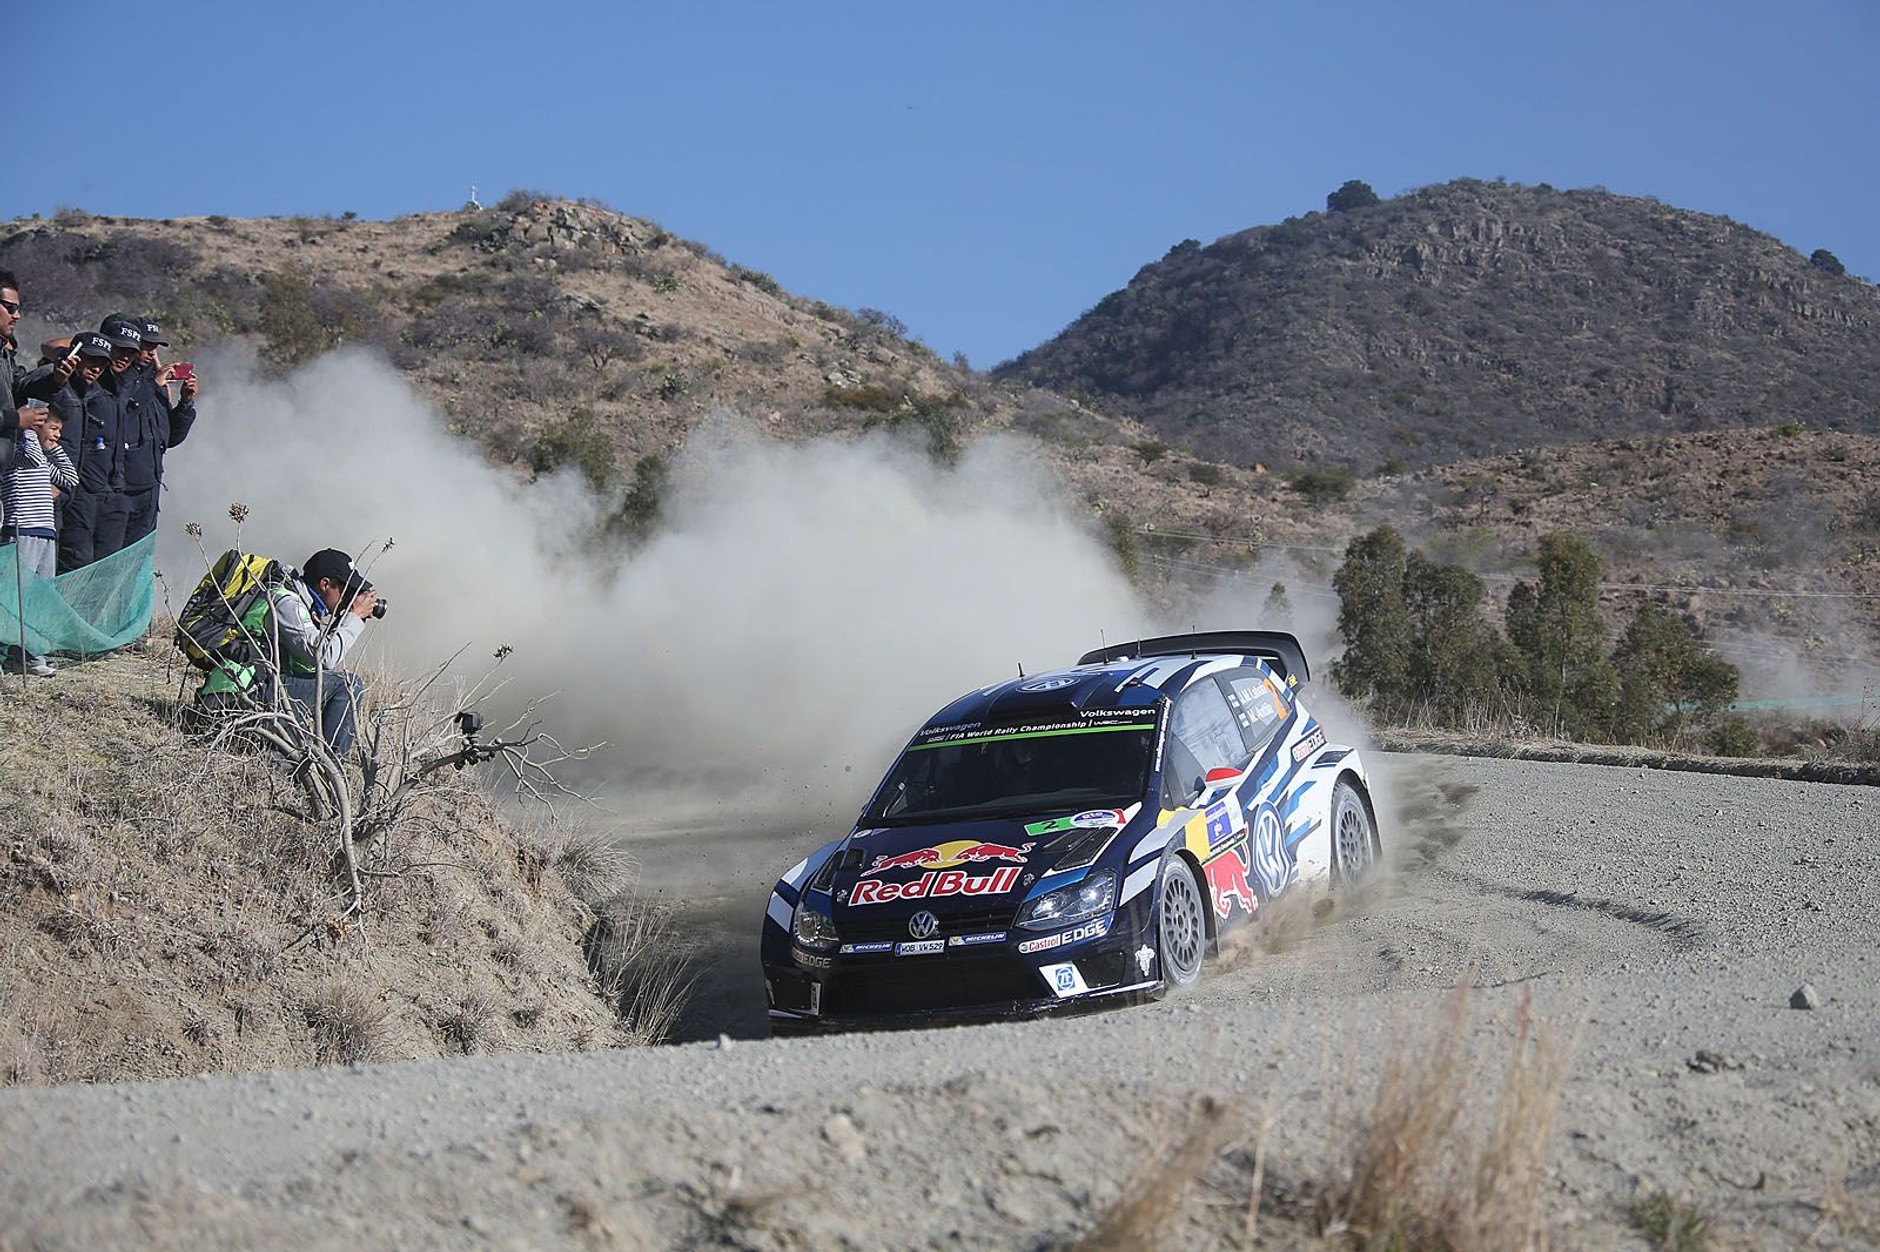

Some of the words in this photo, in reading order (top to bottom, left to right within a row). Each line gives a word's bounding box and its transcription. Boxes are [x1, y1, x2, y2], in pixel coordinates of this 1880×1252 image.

[1080, 708, 1155, 718] Volkswagen
[920, 722, 981, 736] Volkswagen
[949, 732, 964, 740] FIA
[967, 729, 993, 738] World
[994, 727, 1018, 735] Rally
[1020, 721, 1086, 732] Championship
[1042, 821, 1059, 830] 2
[849, 872, 933, 906] Red
[931, 867, 1022, 897] Bull
[965, 934, 1005, 942] MICHELIN
[1029, 937, 1060, 951] Castrol
[1061, 920, 1106, 945] EDGE
[803, 953, 832, 968] EDGE
